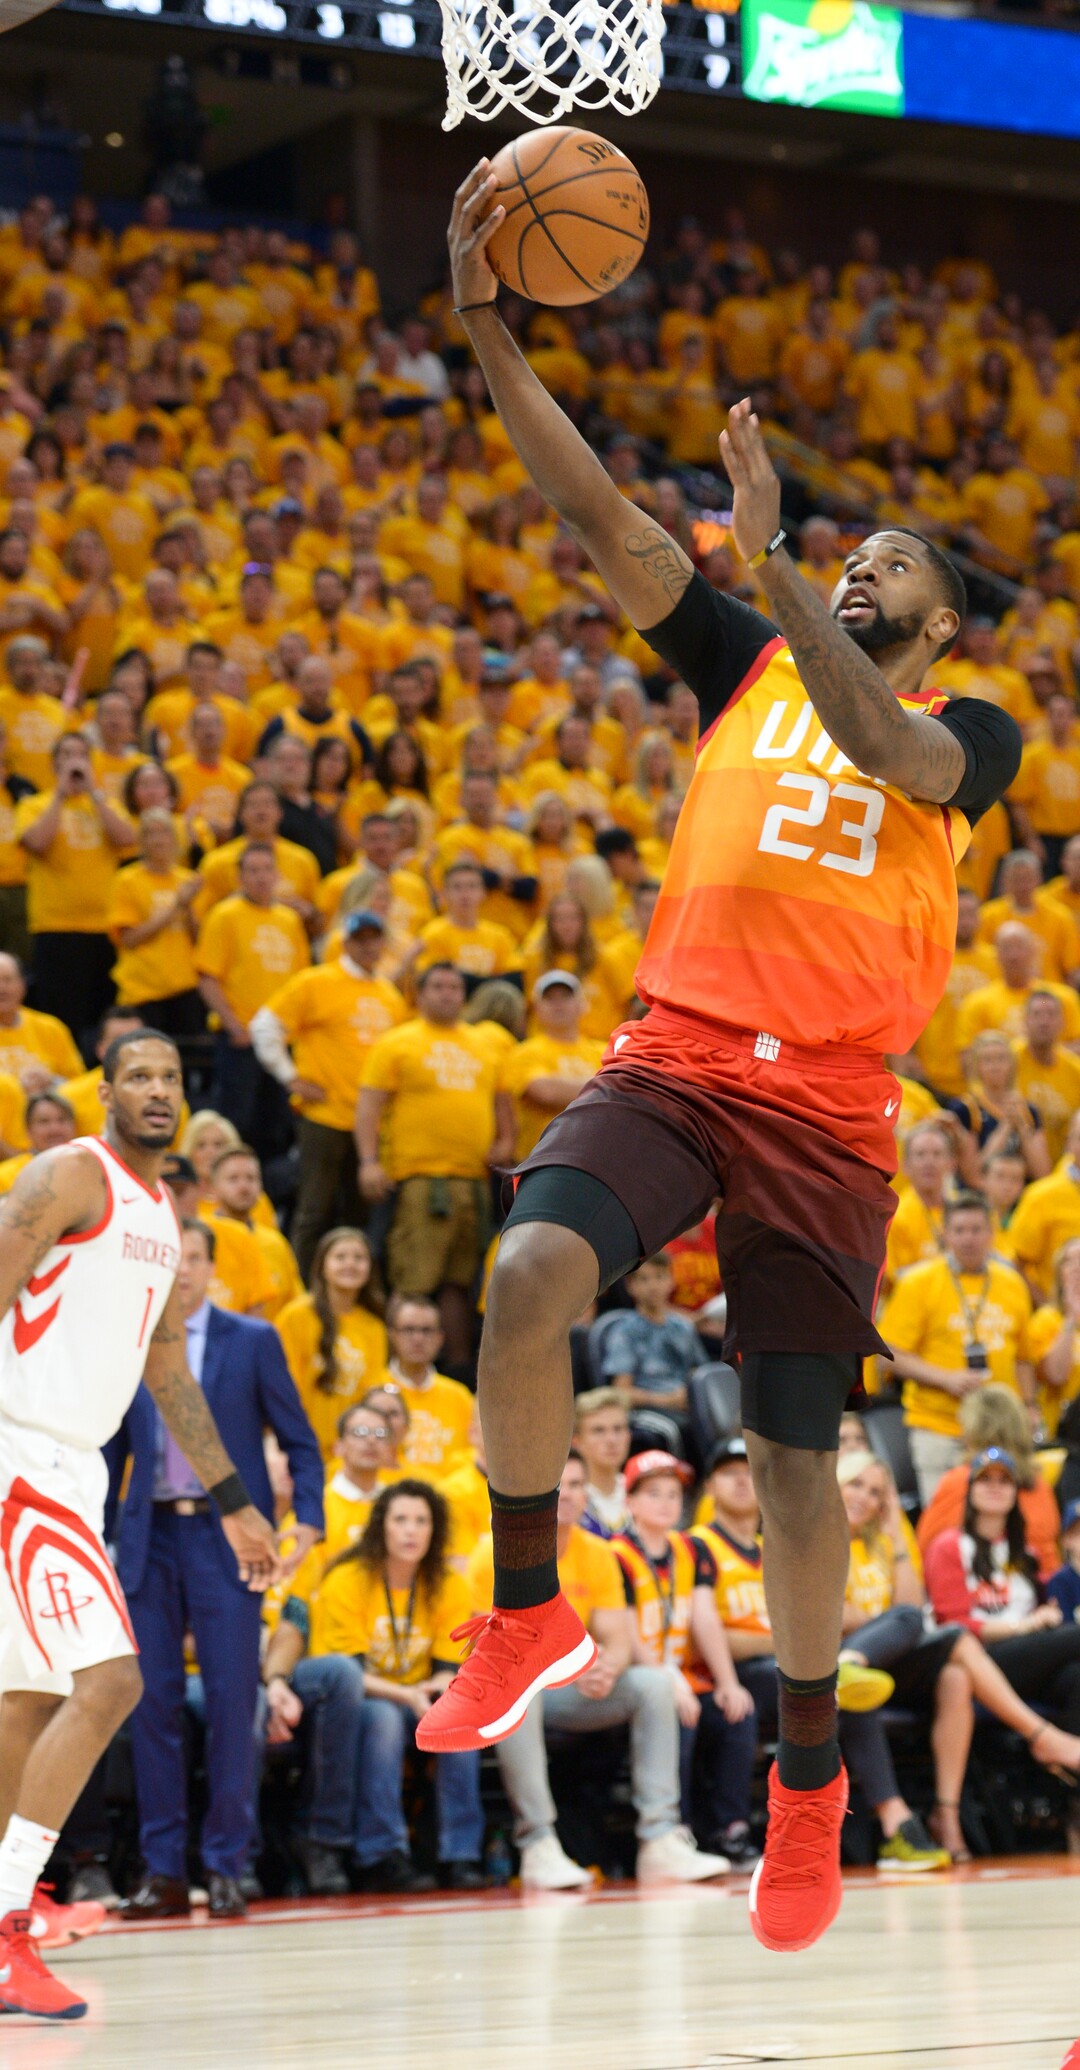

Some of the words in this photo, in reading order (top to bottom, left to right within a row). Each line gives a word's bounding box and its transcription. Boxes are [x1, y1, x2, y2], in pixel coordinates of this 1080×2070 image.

[757, 771, 886, 878] 23
[122, 1231, 179, 1269] ROCKET
[137, 1286, 154, 1349] 1
